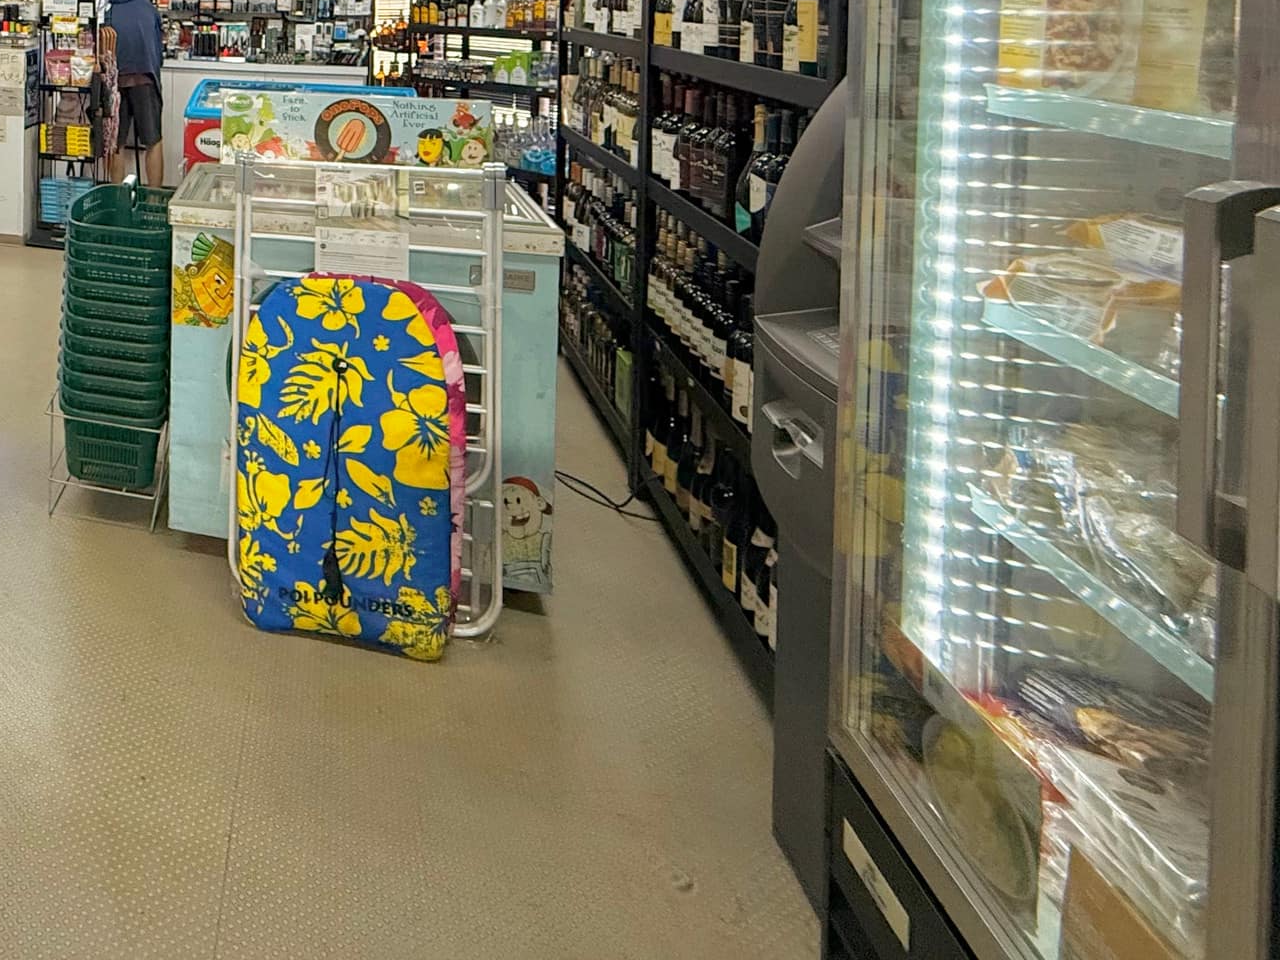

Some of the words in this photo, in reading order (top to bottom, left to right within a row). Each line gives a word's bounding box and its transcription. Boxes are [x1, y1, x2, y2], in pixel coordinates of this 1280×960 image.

[392, 100, 437, 112] Nothing
[390, 109, 440, 120] Artificial
[199, 136, 221, 148] Häag
